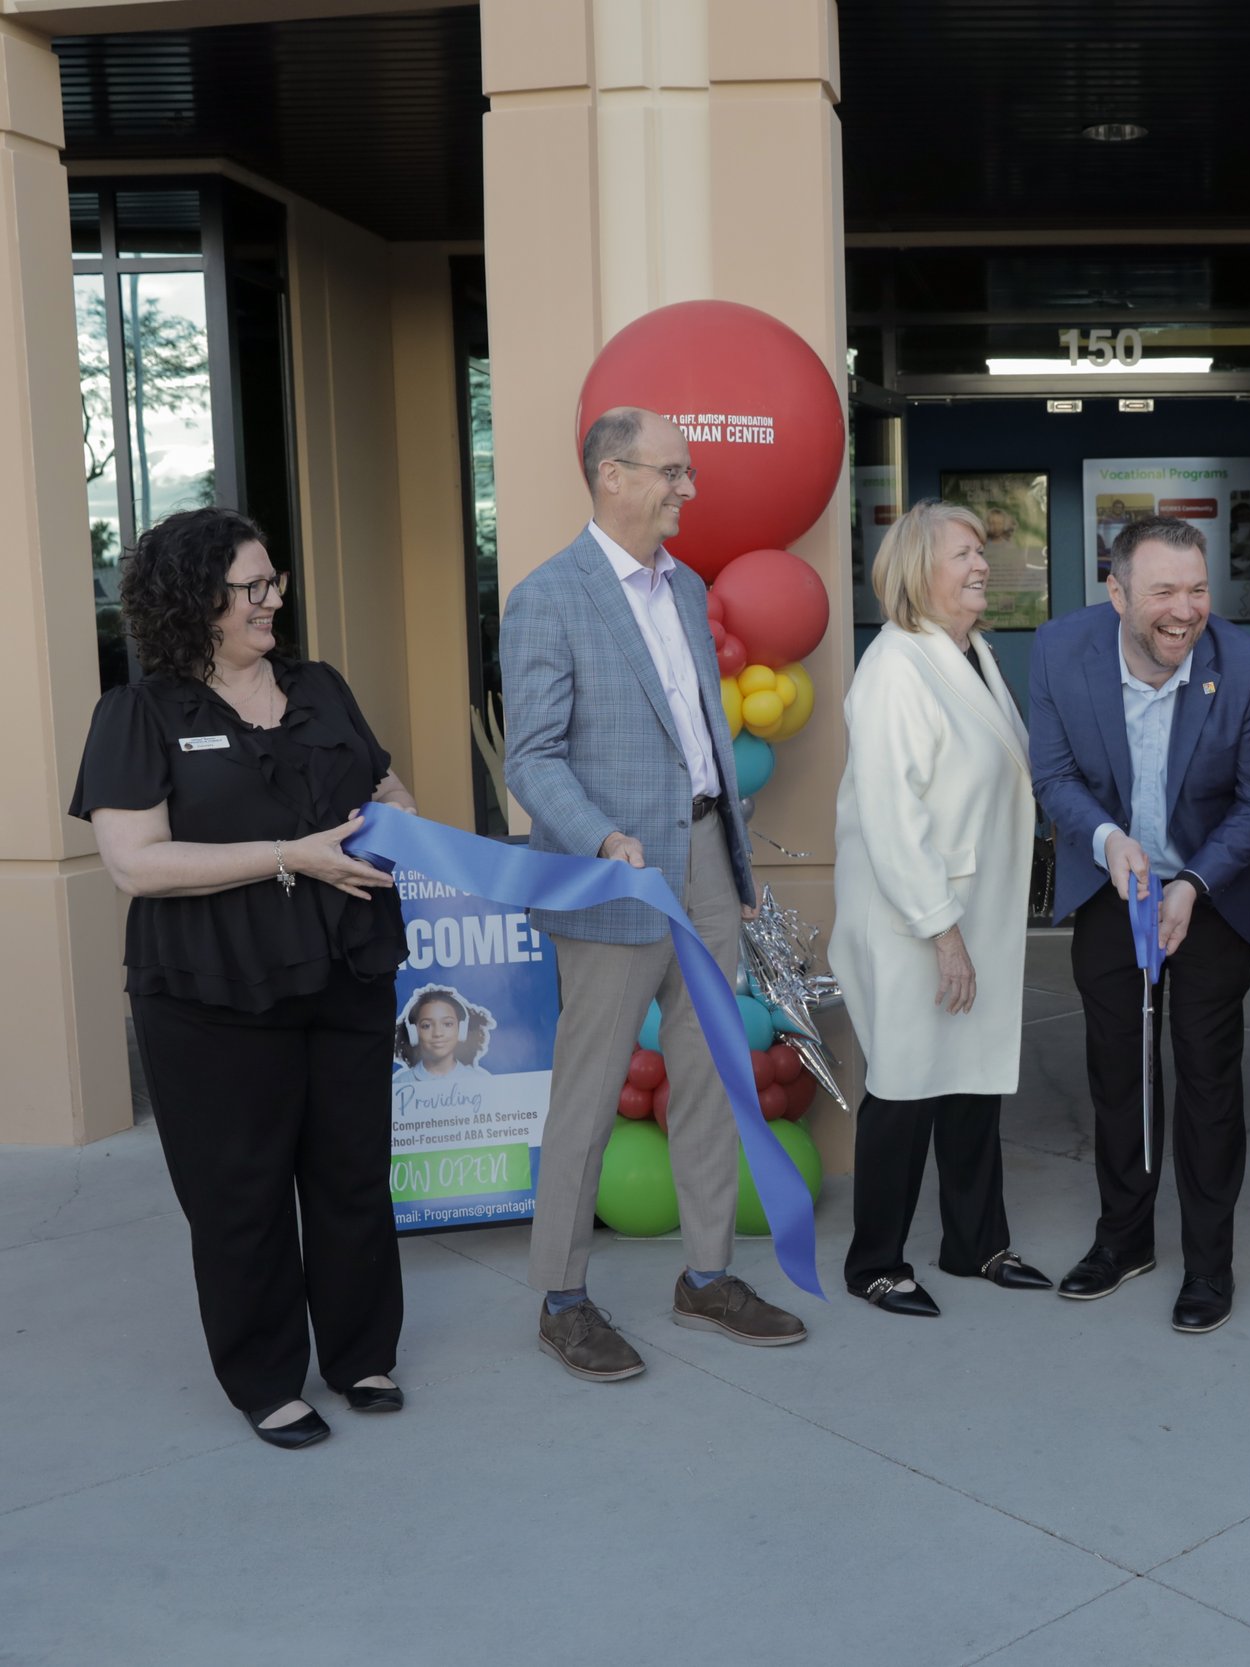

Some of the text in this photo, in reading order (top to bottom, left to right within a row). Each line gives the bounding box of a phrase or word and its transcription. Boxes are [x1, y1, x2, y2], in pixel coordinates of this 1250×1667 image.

[1058, 328, 1143, 367] 150
[672, 414, 678, 424] A
[698, 414, 726, 424] AUTISM
[727, 415, 773, 426] FOUNDATION
[726, 426, 775, 444] CENTER
[1100, 468, 1228, 482] Vocational Programs
[399, 871, 406, 881] A
[398, 881, 456, 900] ERMAN
[399, 913, 543, 970] COME!
[395, 1082, 482, 1117] Providing
[392, 1110, 538, 1132] Comprehensive ABA Services
[464, 1129, 484, 1141] ABA
[487, 1126, 529, 1139] Services
[439, 1151, 508, 1186] OPEN
[394, 1199, 536, 1225] mail: Programs@grantagift
